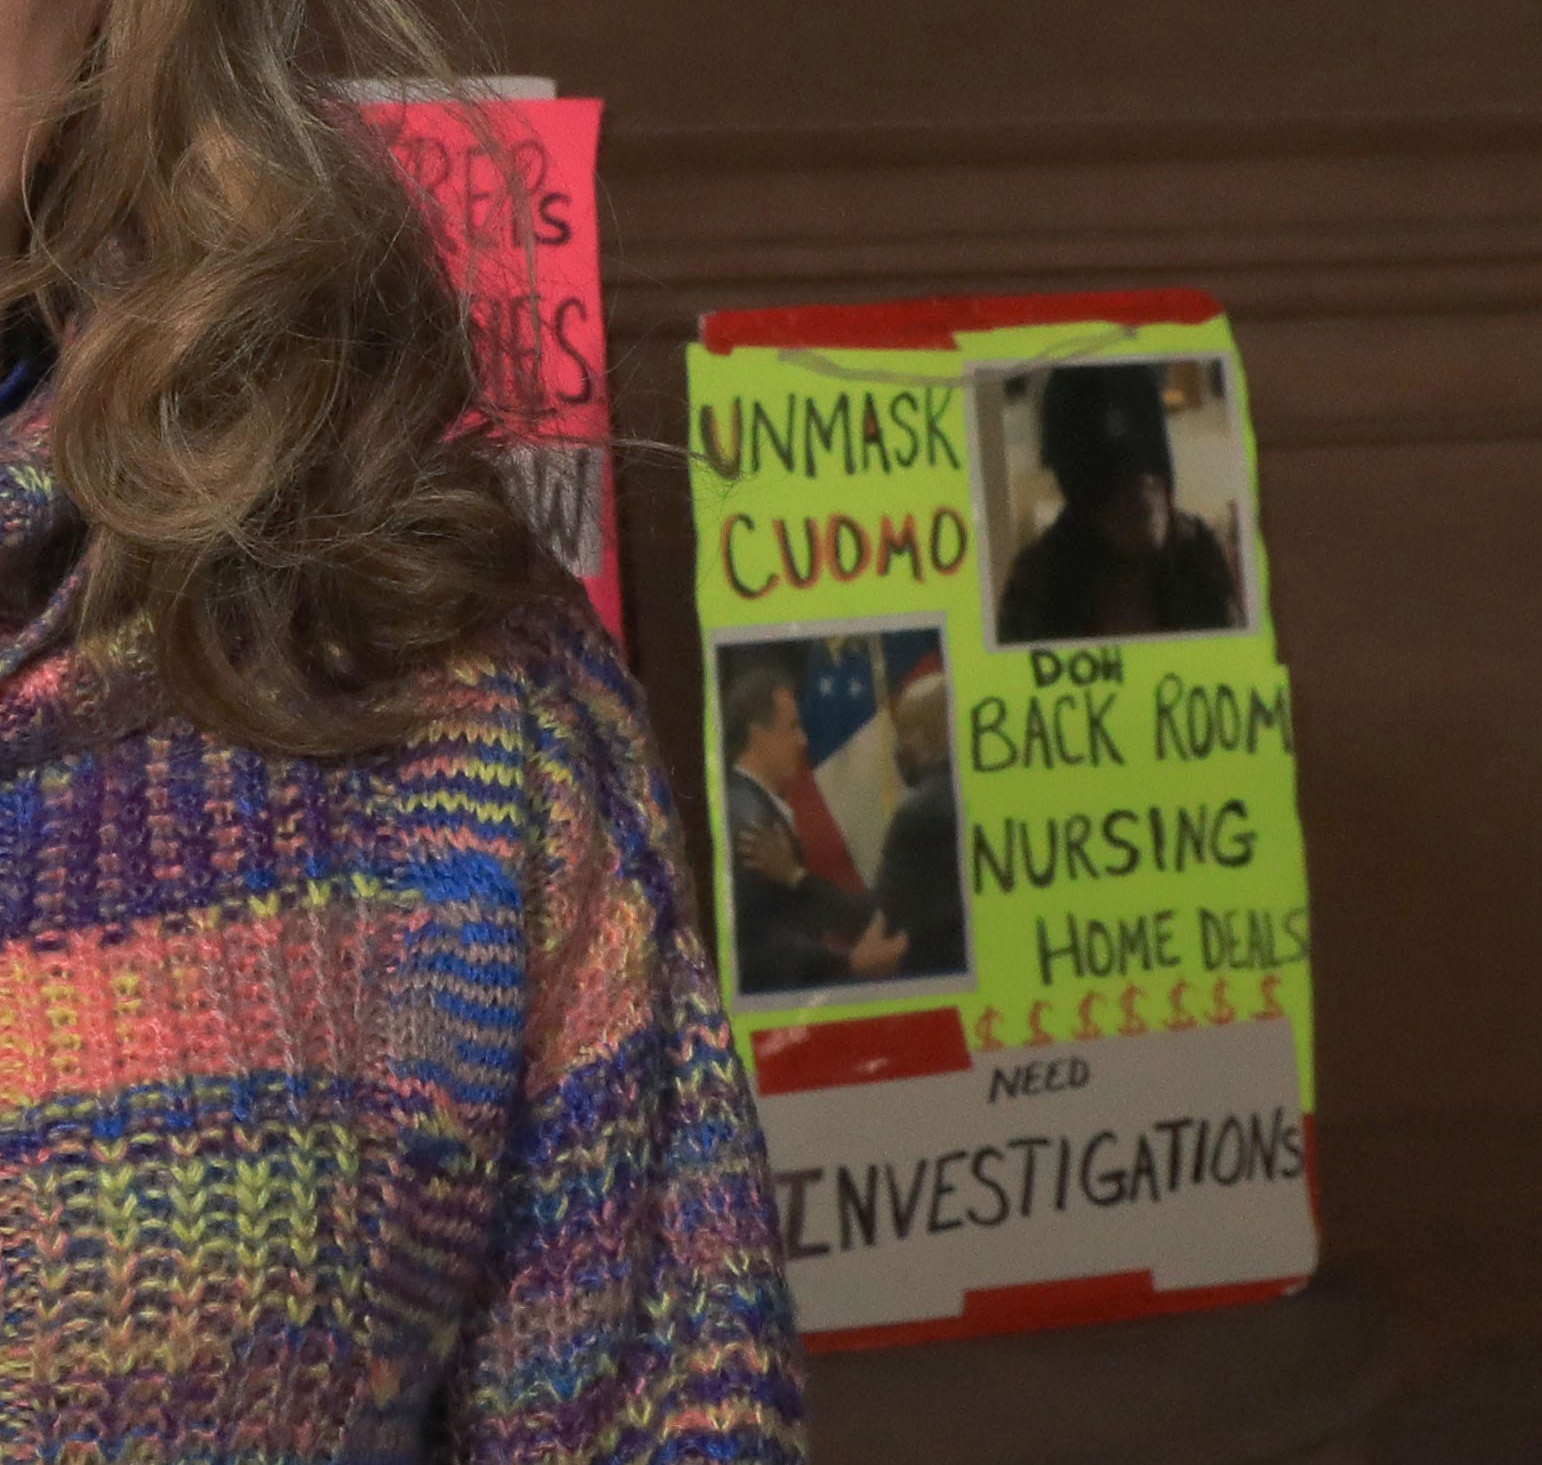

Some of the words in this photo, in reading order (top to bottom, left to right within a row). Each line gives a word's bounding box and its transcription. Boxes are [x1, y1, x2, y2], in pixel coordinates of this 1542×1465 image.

[699, 386, 962, 481] UNMASK
[722, 506, 969, 600] CUOMO
[1032, 648, 1124, 687] DOH
[969, 692, 1125, 773] BACK
[1154, 673, 1294, 761] ROOM
[973, 799, 1257, 896] NURSING
[1035, 910, 1182, 986] HOME
[1200, 905, 1309, 972] DEALS
[987, 1056, 1091, 1104] NEED
